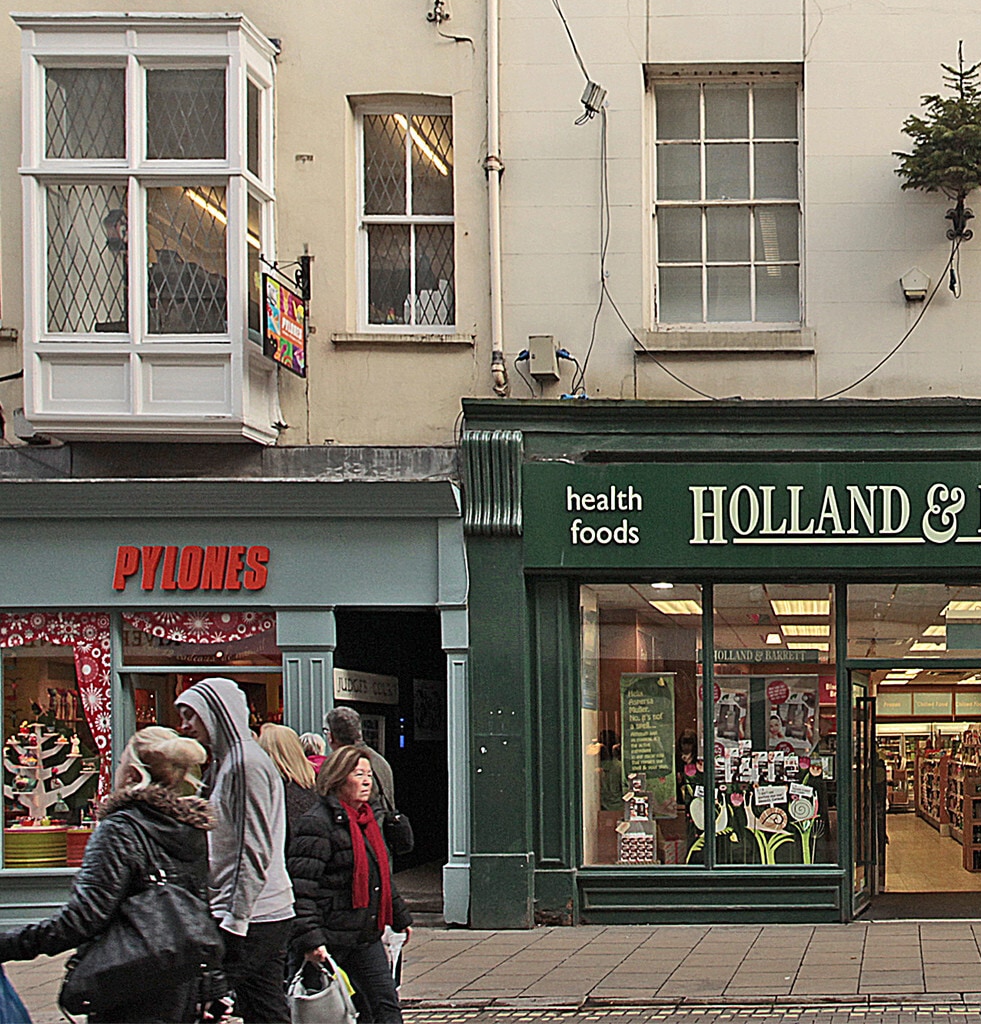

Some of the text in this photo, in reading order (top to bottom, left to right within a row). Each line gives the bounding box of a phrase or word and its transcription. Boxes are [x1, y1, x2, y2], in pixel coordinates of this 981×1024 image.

[566, 486, 643, 511] health
[689, 484, 911, 544] HOLLAND
[922, 483, 966, 543] &
[570, 519, 640, 545] foods
[112, 545, 270, 591] PYLONES
[765, 650, 806, 662] BARRETT
